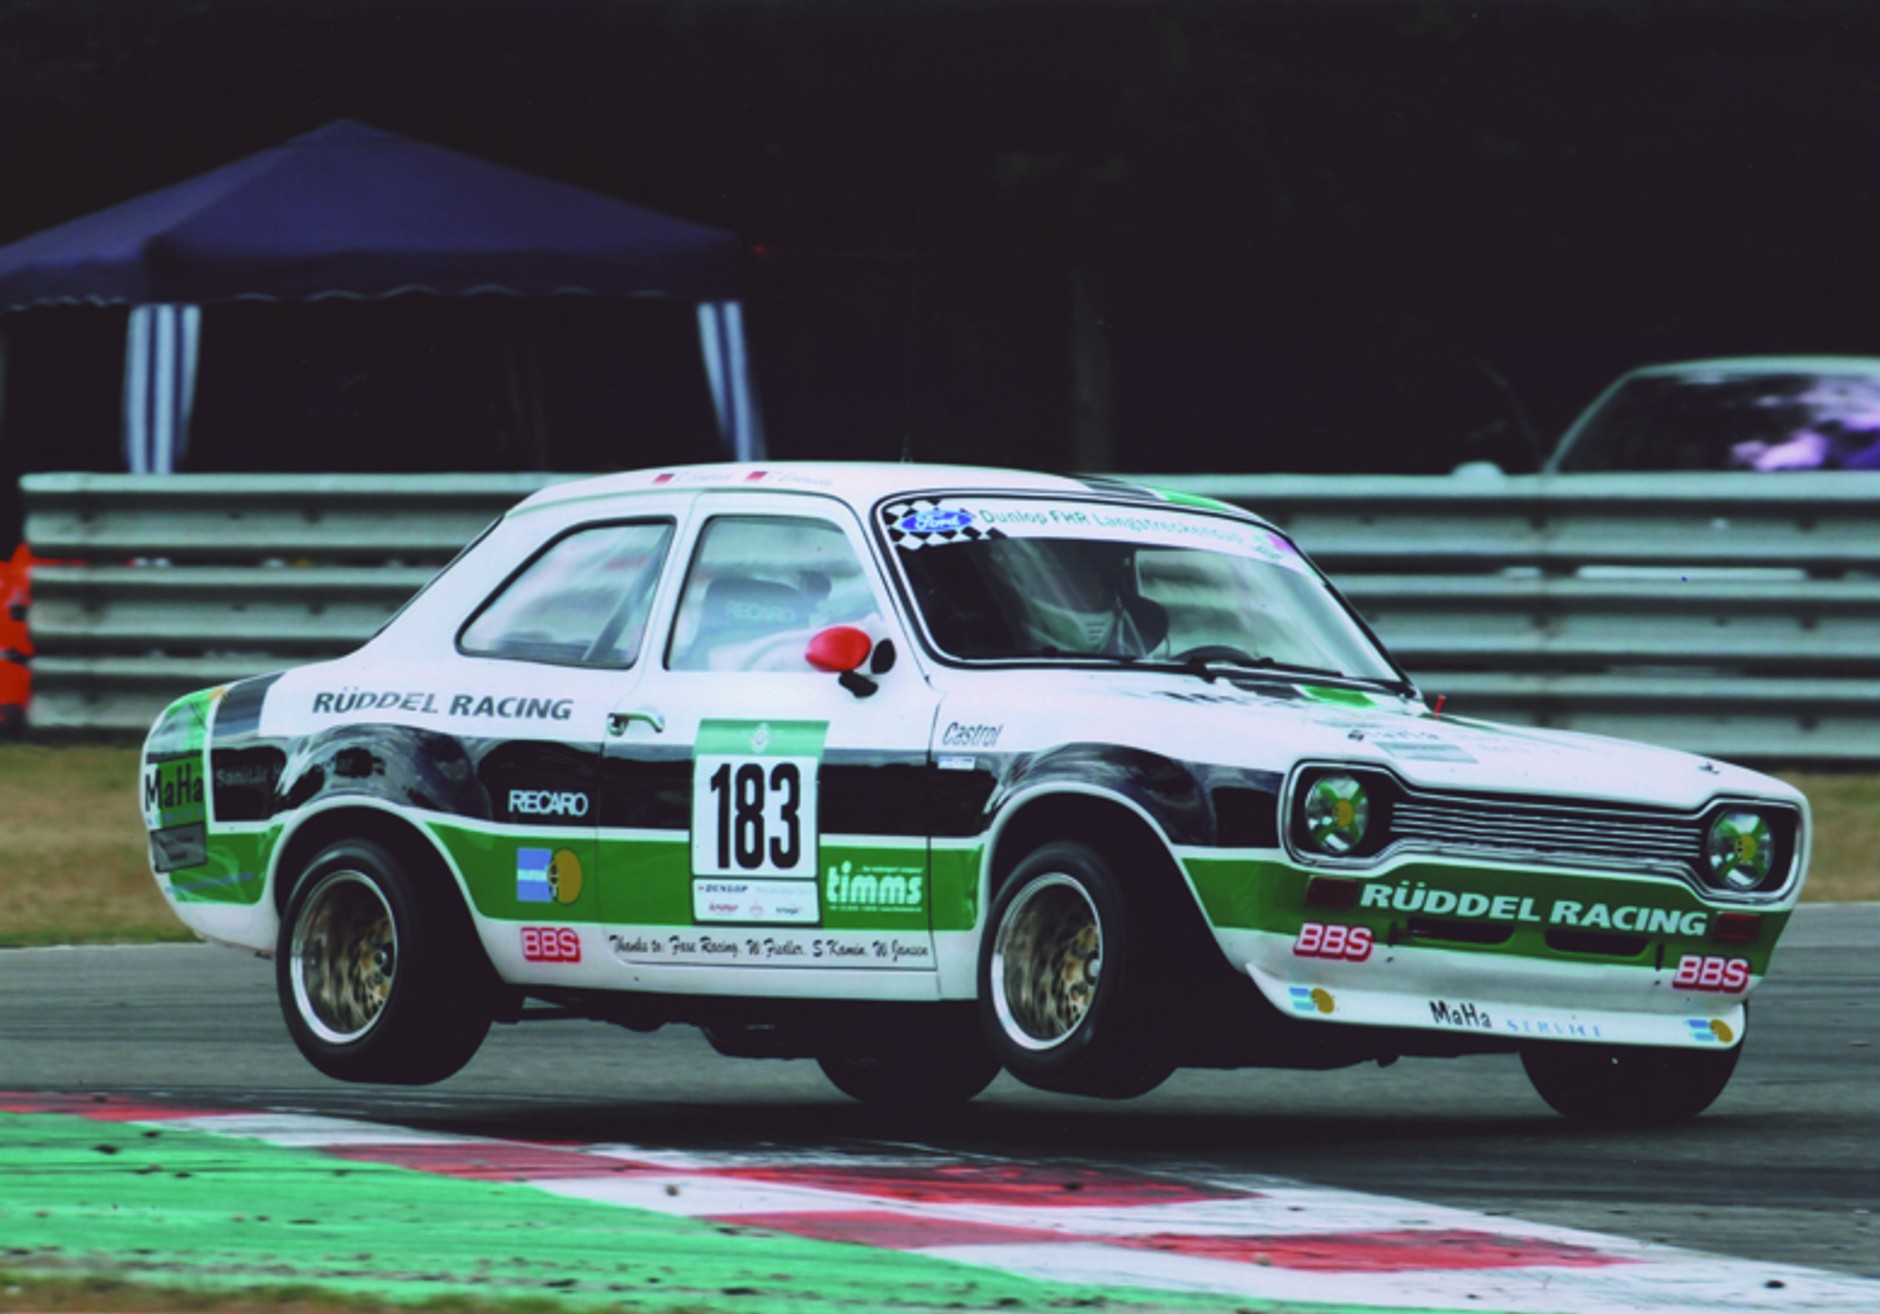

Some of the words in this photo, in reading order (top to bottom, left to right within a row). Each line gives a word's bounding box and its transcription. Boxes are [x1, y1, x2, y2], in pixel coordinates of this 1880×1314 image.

[915, 510, 960, 530] Ford
[978, 509, 1048, 526] Dunlop
[1048, 509, 1091, 525] FHR
[312, 686, 439, 714] RÜDDEL
[448, 694, 574, 721] RACING
[942, 721, 1004, 748] Castrol
[145, 763, 204, 812] MaHa
[508, 789, 589, 817] RECARO
[710, 763, 801, 870] 183
[705, 884, 749, 894] DUNLOP
[826, 860, 924, 905] timms
[1360, 879, 1541, 922] RÜDDEL
[1550, 899, 1708, 936] RACING
[521, 927, 581, 963] BBS
[609, 934, 648, 955] Thanks
[1293, 922, 1374, 962] BBS
[1672, 954, 1750, 994] BBS
[1428, 1000, 1492, 1029] MaHa
